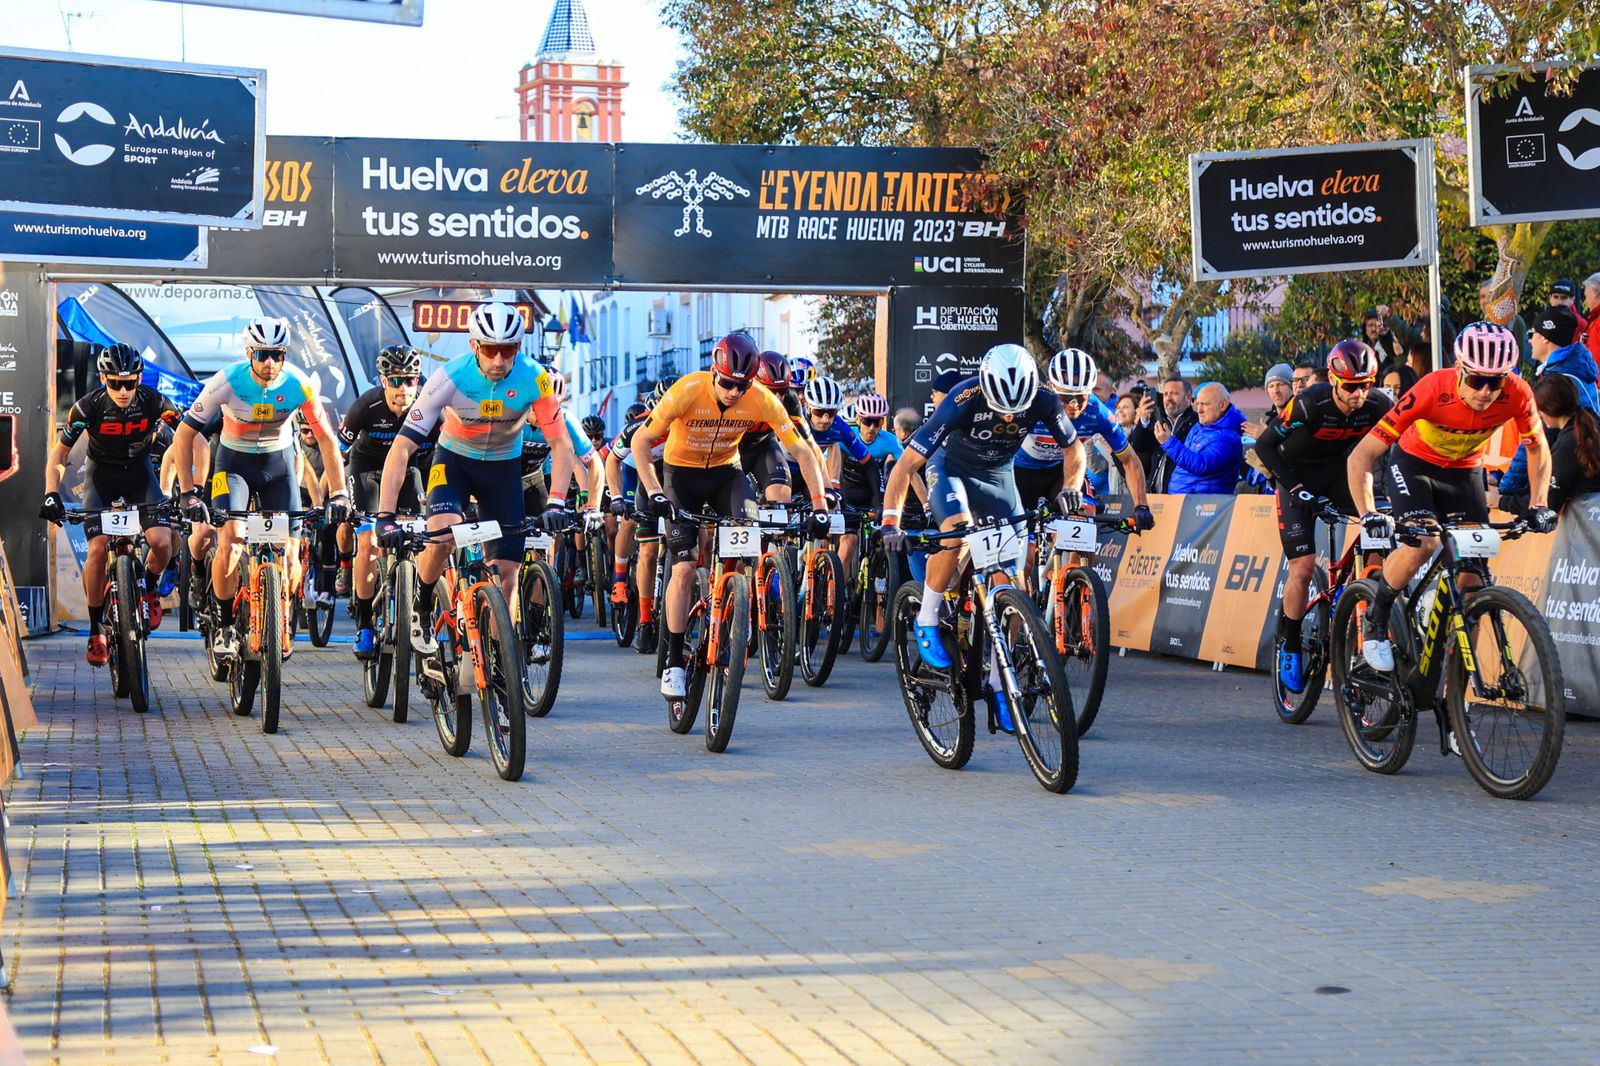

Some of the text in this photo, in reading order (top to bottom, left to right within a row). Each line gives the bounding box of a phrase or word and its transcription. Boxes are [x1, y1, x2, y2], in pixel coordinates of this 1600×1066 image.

[123, 112, 226, 145] Andalucía
[123, 155, 158, 165] SPORT
[124, 144, 216, 160] European Region of
[362, 157, 589, 195] Huelva eleva
[761, 170, 775, 186] LA
[1230, 168, 1380, 202] Huelva eleva
[758, 170, 878, 212] LEYENDA
[881, 195, 895, 212] DE
[262, 210, 308, 227] BH
[362, 206, 590, 241] tus sentidos.
[1231, 202, 1382, 233] tus sentidos.
[13, 222, 147, 241] www.turismohuelva.org
[756, 215, 790, 239] MTB
[797, 216, 839, 241] RACE
[846, 217, 905, 242] HUELVA
[912, 219, 955, 242] 2023
[963, 221, 1007, 238] BH
[1242, 233, 1365, 251] www.turismohuelva.org
[378, 251, 562, 271] www.turismohuelva.org
[923, 256, 961, 273] UCI
[940, 304, 998, 316] DIPUTACIÓN
[940, 316, 998, 325] DE HUELVA
[485, 404, 499, 413] Buff
[973, 411, 994, 423] BH
[99, 418, 148, 435] BH
[1390, 464, 1411, 496] SCOTT
[111, 514, 128, 526] 31
[264, 519, 273, 532] 9
[729, 531, 749, 545] 33
[1071, 525, 1081, 539] 2
[1471, 531, 1483, 543] 6
[982, 532, 1003, 551] 17
[1171, 543, 1219, 565] Huelva eleva
[1125, 554, 1162, 577] FUERTE
[1224, 554, 1270, 593] BH
[1551, 557, 1600, 586] Huelva
[1165, 570, 1211, 591] tus sentidos.
[1545, 594, 1568, 620] tus
